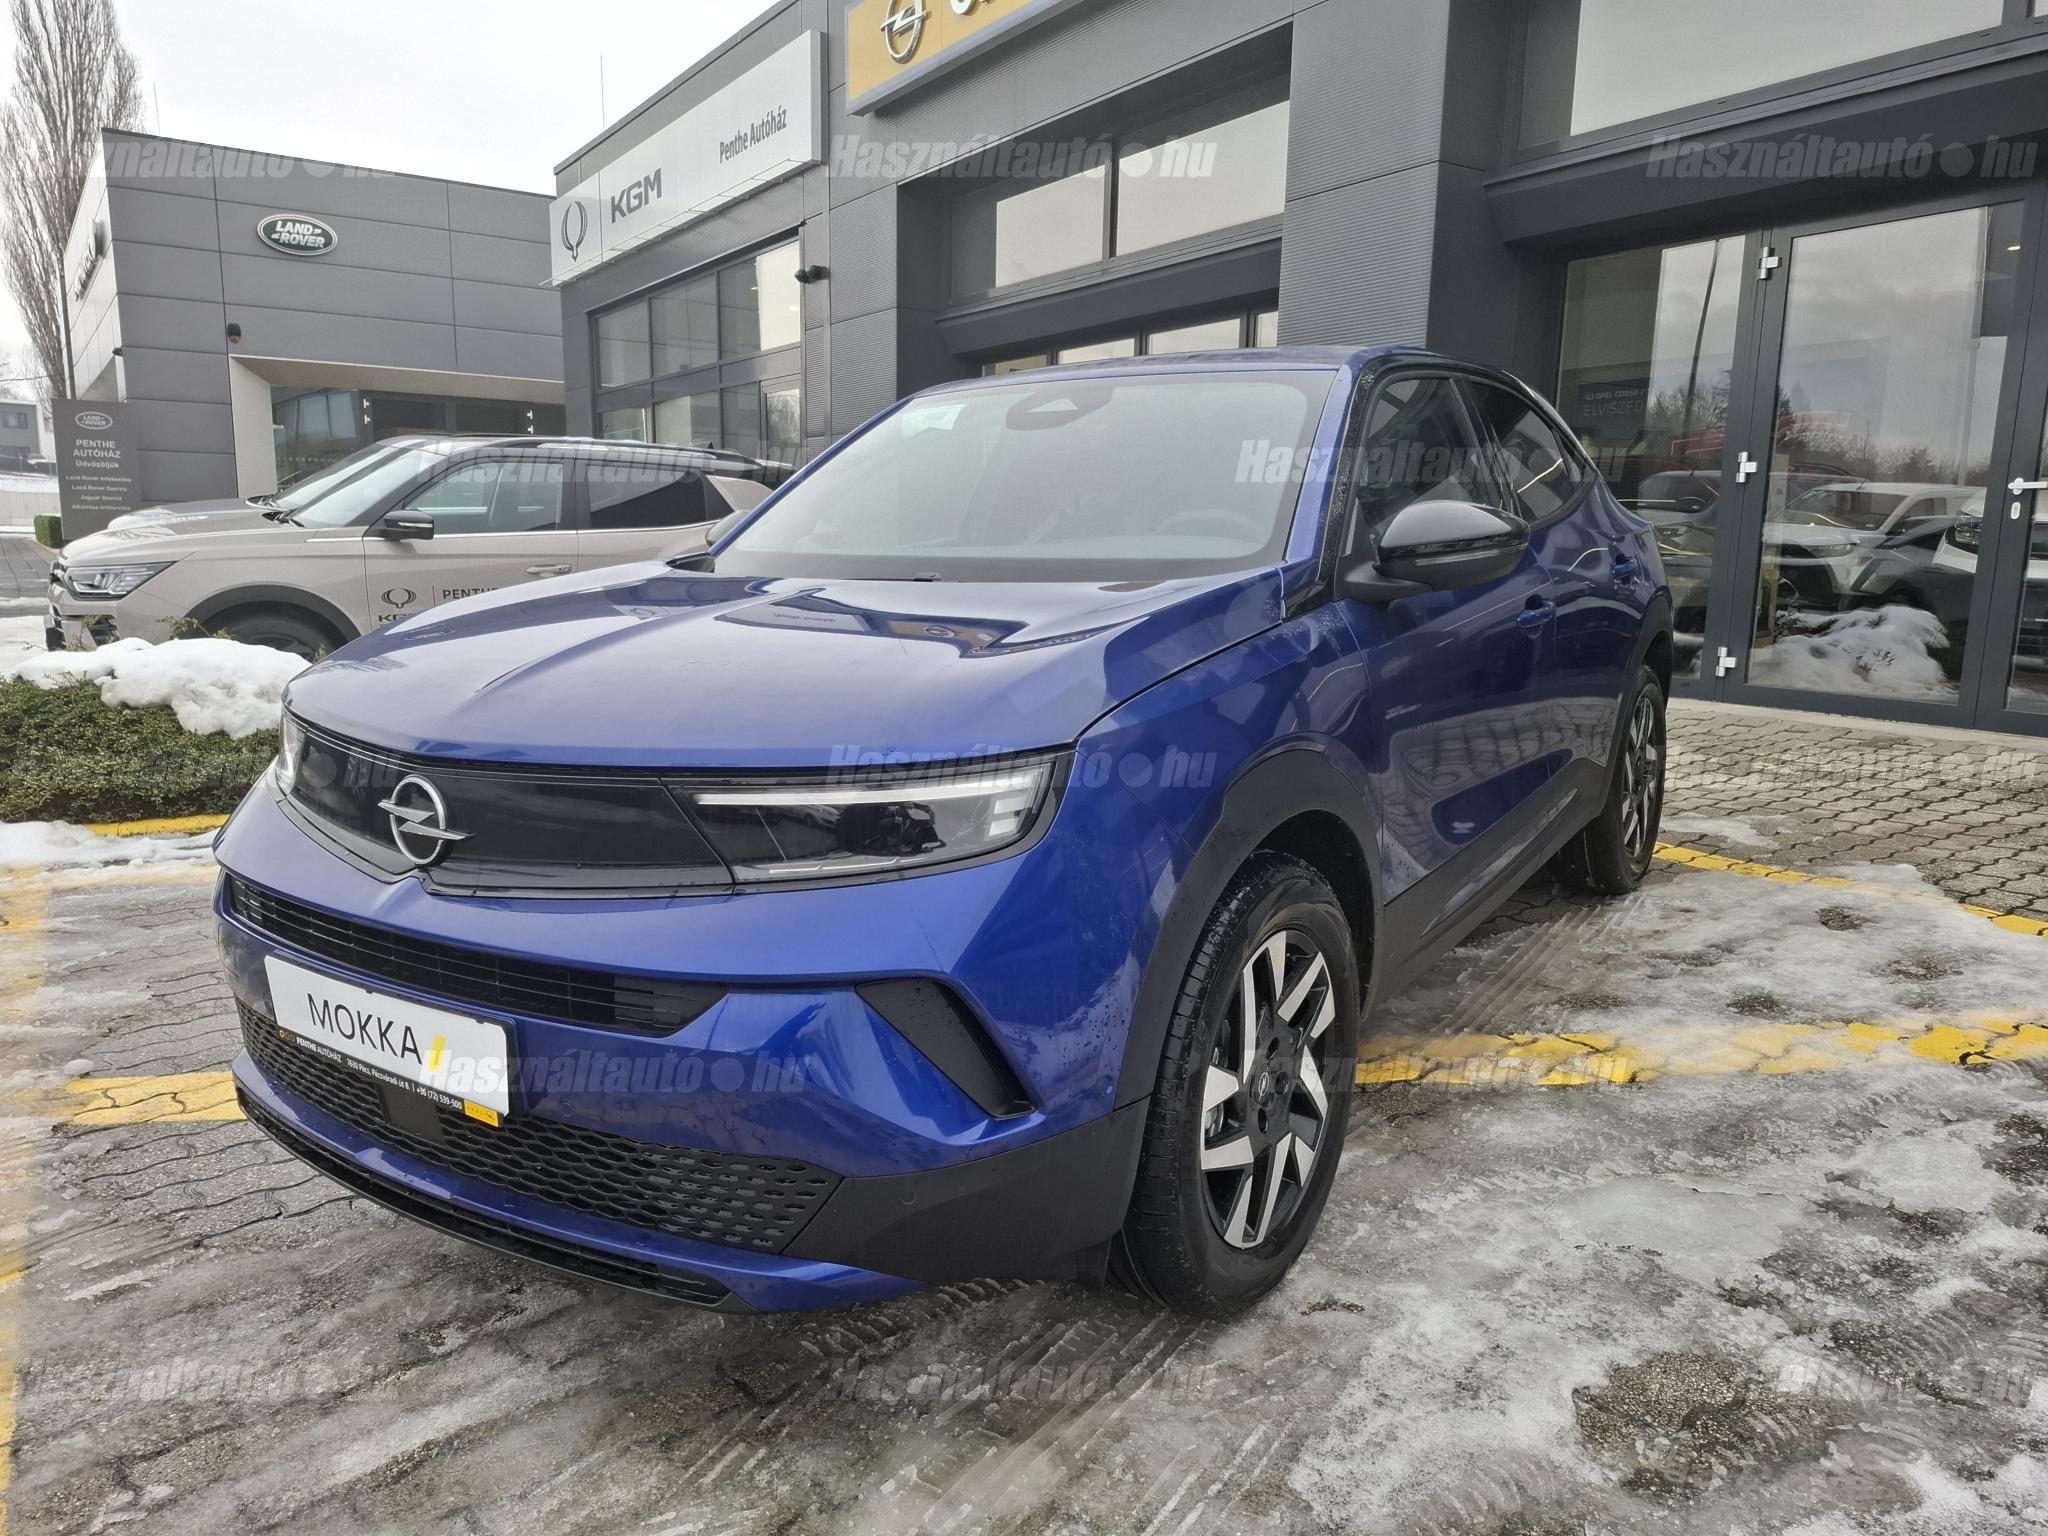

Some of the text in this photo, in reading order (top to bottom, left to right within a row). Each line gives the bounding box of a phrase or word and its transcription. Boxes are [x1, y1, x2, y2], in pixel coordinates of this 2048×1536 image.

[719, 104, 787, 164] Penthe Autóház
[610, 167, 663, 225] KGM
[275, 220, 314, 235] LAND
[279, 232, 326, 248] ROVER
[75, 439, 116, 449] PENTHE
[73, 448, 121, 459] AUTÓHÁZ
[306, 992, 423, 1066] MOKKA
[296, 1036, 318, 1053] PENTHE
